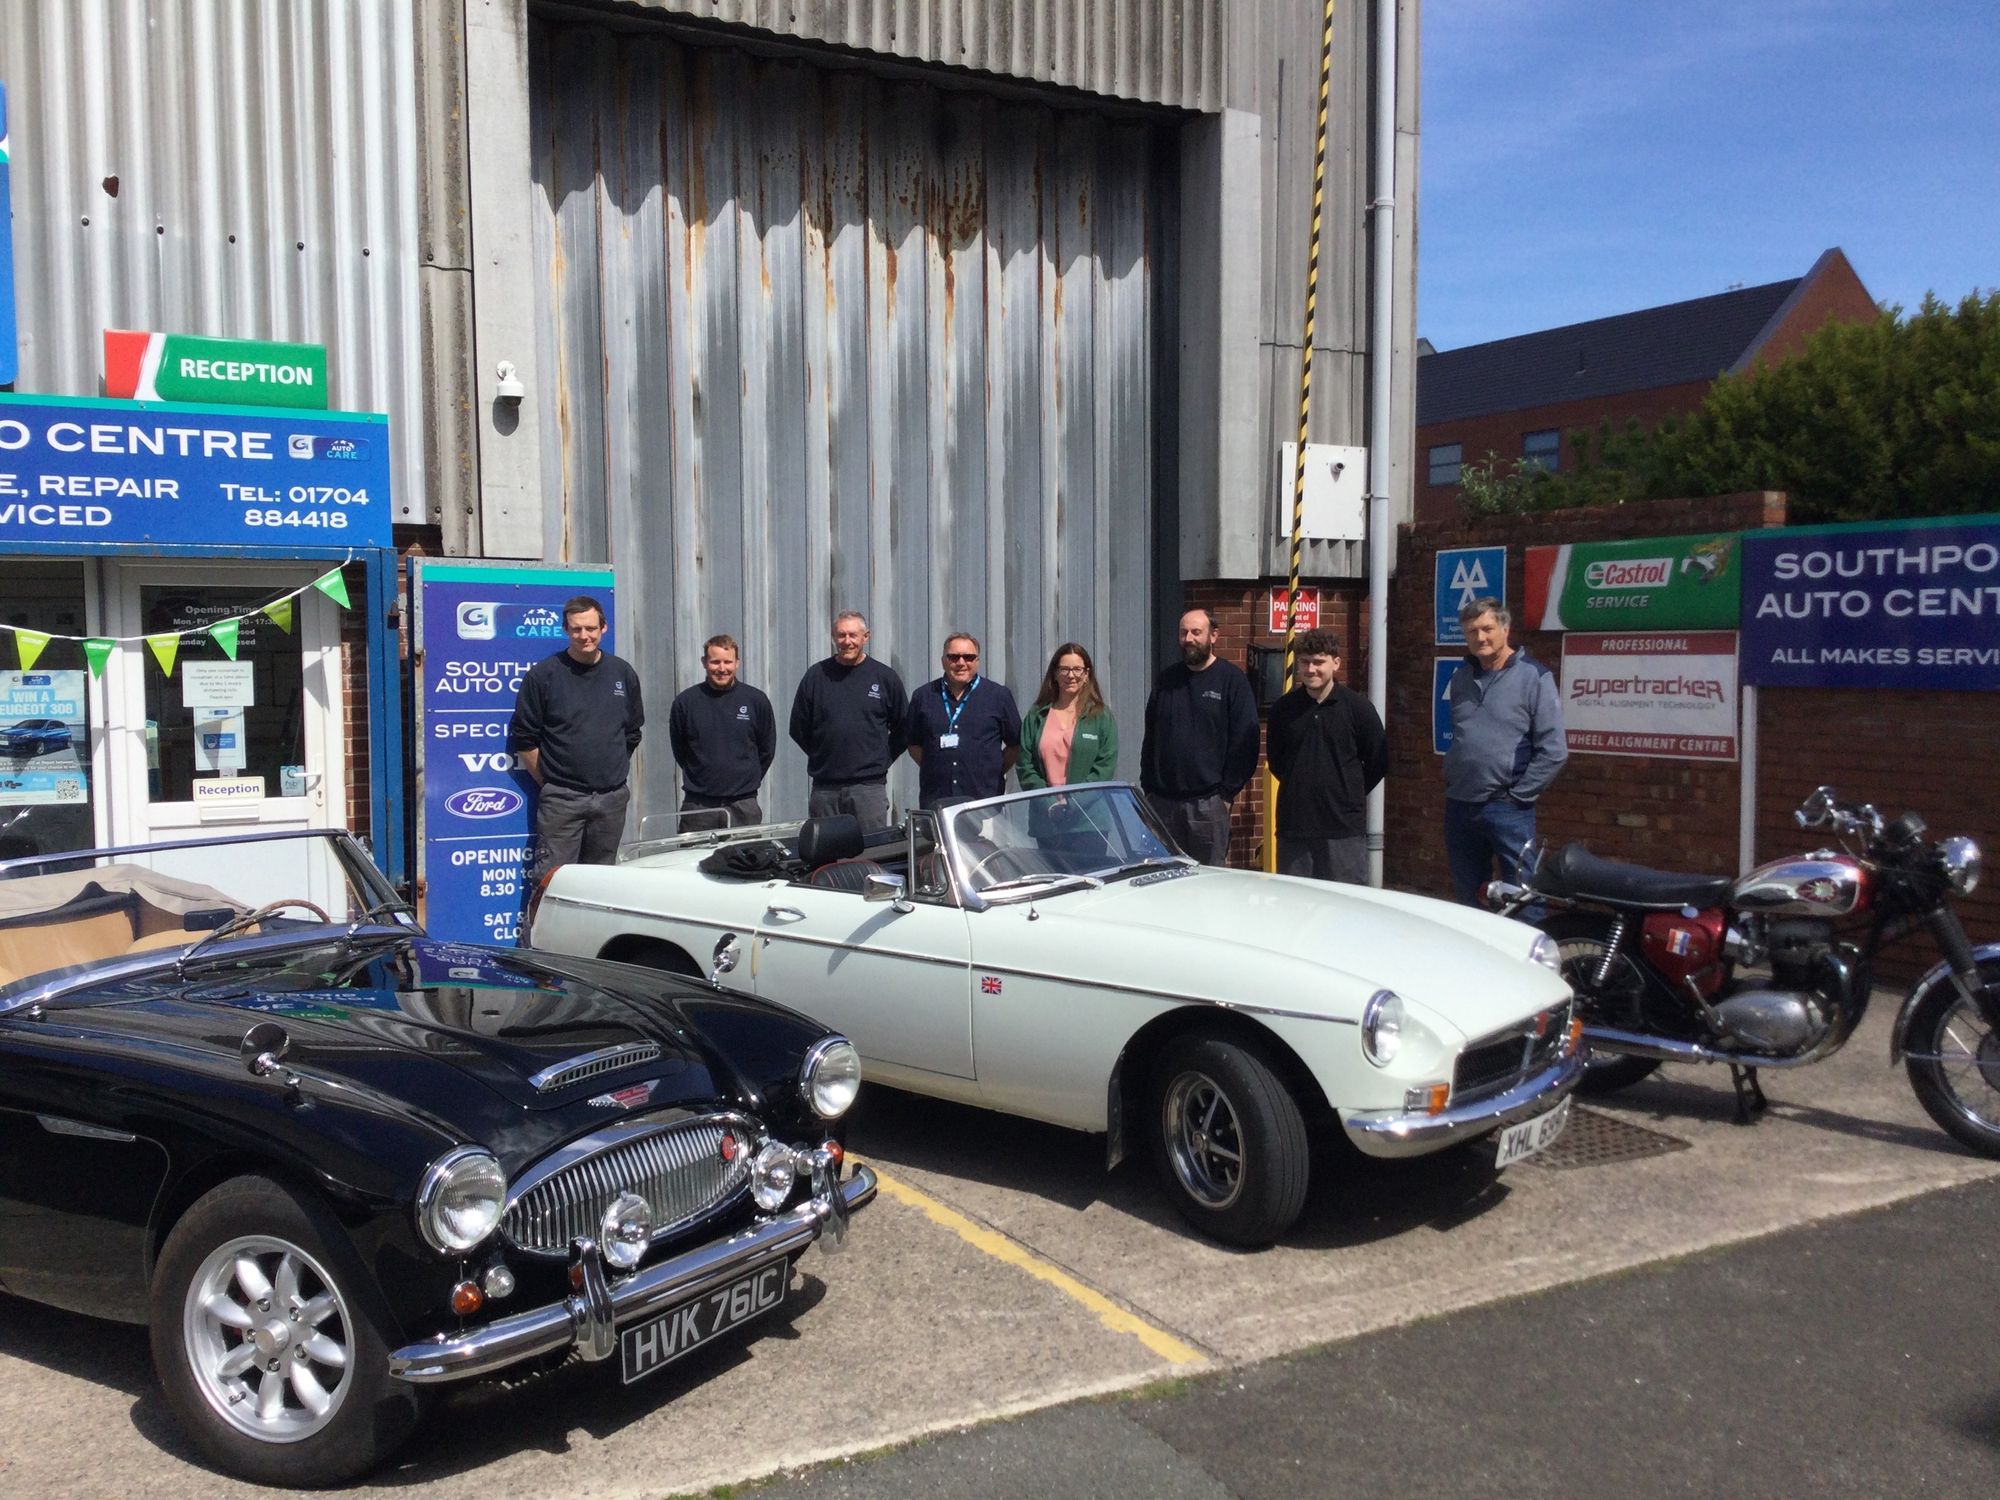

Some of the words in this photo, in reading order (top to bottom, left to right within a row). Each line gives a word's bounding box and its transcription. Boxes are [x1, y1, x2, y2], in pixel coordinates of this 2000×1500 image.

[180, 358, 313, 386] RECEPTION
[47, 422, 274, 460] CENTRE
[326, 450, 357, 459] CARE
[39, 475, 179, 499] REPAIR
[220, 483, 281, 503] TEL:
[288, 486, 369, 505] 01704
[244, 510, 348, 528] 884418
[1605, 562, 1666, 585] Castrol
[1274, 601, 1316, 612] PAKING
[1586, 595, 1650, 609] SERVICE
[1755, 590, 1871, 619] AUTO
[185, 605, 231, 615] Opening
[523, 617, 554, 626] AUTO
[515, 626, 562, 637] CARE
[1601, 639, 1688, 651] PROFESSIONAL
[1771, 648, 1815, 664] ALL
[1820, 648, 1911, 665] MAKES
[1917, 648, 2000, 665] SERVI
[445, 661, 538, 677] SOUTH
[435, 678, 503, 693] AUTO
[12, 690, 38, 703] WIN
[41, 690, 50, 702] A
[50, 703, 73, 715] 308
[1577, 699, 1605, 707] DIGITAL
[1609, 700, 1653, 709] ALIGNMENT
[1658, 701, 1716, 710] TECHNOLOGY
[1567, 733, 1604, 746] WHEEL
[1607, 735, 1676, 750] ALIGNMENT
[1679, 738, 1728, 753] CENTRE
[199, 784, 260, 796] Reception
[462, 792, 507, 813] Ford
[451, 848, 533, 866] OPENING
[482, 868, 517, 882] MON
[480, 883, 515, 897] 8.30
[484, 912, 512, 927] SAT
[1503, 1125, 1533, 1161] XHL
[635, 1302, 701, 1372] HVK
[710, 1268, 778, 1332] 761C
